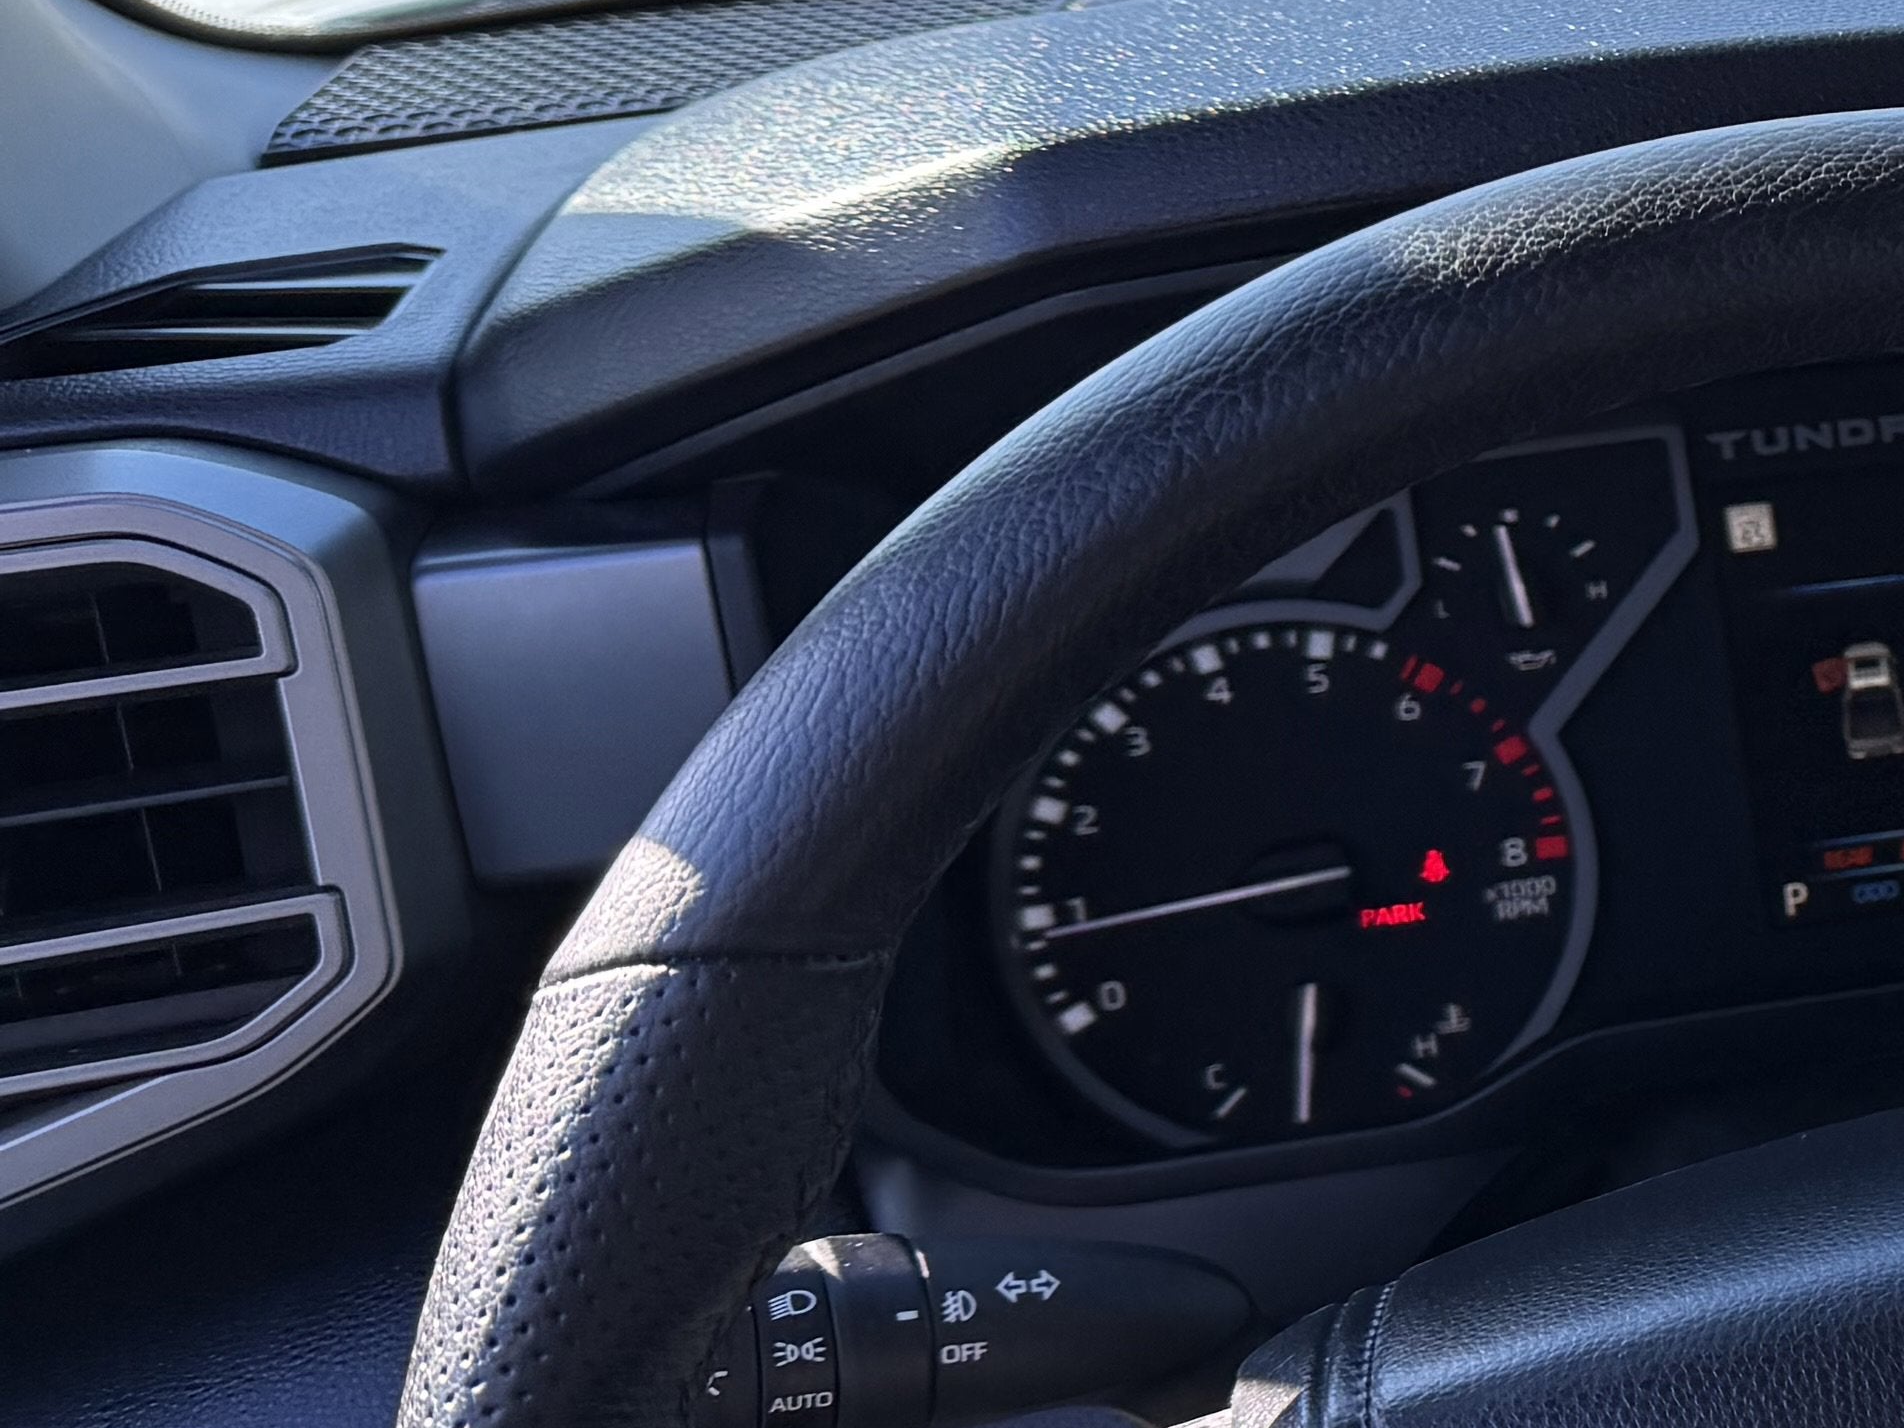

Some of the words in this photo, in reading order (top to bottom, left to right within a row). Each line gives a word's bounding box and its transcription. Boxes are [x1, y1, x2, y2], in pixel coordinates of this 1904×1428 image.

[1586, 580, 1609, 600] H
[1206, 676, 1233, 705] 4
[1306, 664, 1332, 695] 5
[1397, 694, 1422, 721] 6
[1125, 726, 1152, 758] 3
[1464, 761, 1486, 791] 7
[1072, 805, 1099, 836] 2
[1501, 837, 1528, 867] 8
[1496, 898, 1549, 922] RPM
[1783, 881, 1809, 918] P
[1359, 902, 1426, 930] PARK
[1100, 980, 1126, 1011] 0
[1413, 1032, 1439, 1058] H
[1206, 1063, 1224, 1091] C
[940, 1341, 989, 1365] OFF
[768, 1390, 833, 1415] AUTO
